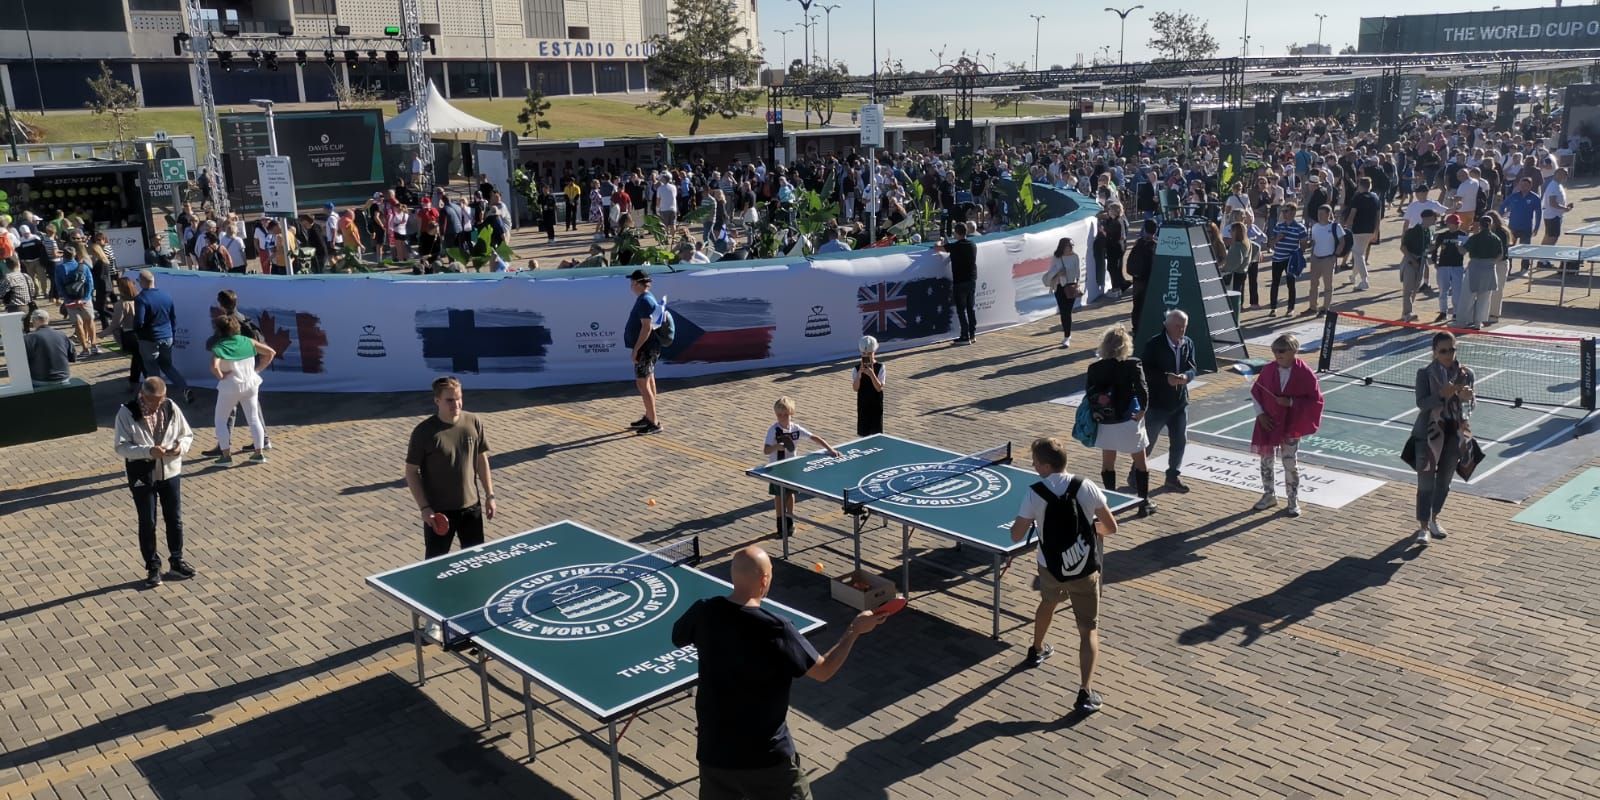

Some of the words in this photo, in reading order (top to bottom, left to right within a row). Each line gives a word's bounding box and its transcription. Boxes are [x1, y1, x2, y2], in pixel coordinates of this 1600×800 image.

[1444, 27, 1475, 42] THE
[1480, 23, 1541, 40] WORLD
[1546, 21, 1583, 37] CUP
[1587, 20, 1600, 35] O
[539, 41, 614, 57] ESTADIO
[625, 43, 657, 57] CIUD
[1308, 435, 1371, 449] WORLD
[1374, 447, 1401, 457] CU
[1312, 442, 1376, 457] TENNIS
[1203, 455, 1255, 468] 2023
[876, 470, 899, 478] CUP
[902, 464, 957, 473] FINALS
[1184, 462, 1261, 481] FINALS
[885, 495, 912, 503] THE
[916, 497, 971, 505] WORLD
[970, 490, 993, 500] CUP
[510, 542, 528, 552] OF
[526, 540, 557, 552] THE
[1062, 533, 1089, 570] NIKE
[449, 549, 507, 569] TENNIS
[470, 549, 526, 569] WORLD
[436, 567, 469, 579] CUP
[497, 589, 524, 613] DAVIS
[521, 574, 553, 588] CUP
[559, 567, 628, 577] FINALS
[508, 618, 540, 632] THE
[540, 622, 610, 635] WORLD
[613, 611, 646, 627] CUP
[643, 599, 663, 611] OF
[616, 660, 658, 677] THE
[653, 643, 698, 662] WOR
[654, 661, 677, 674] OF
